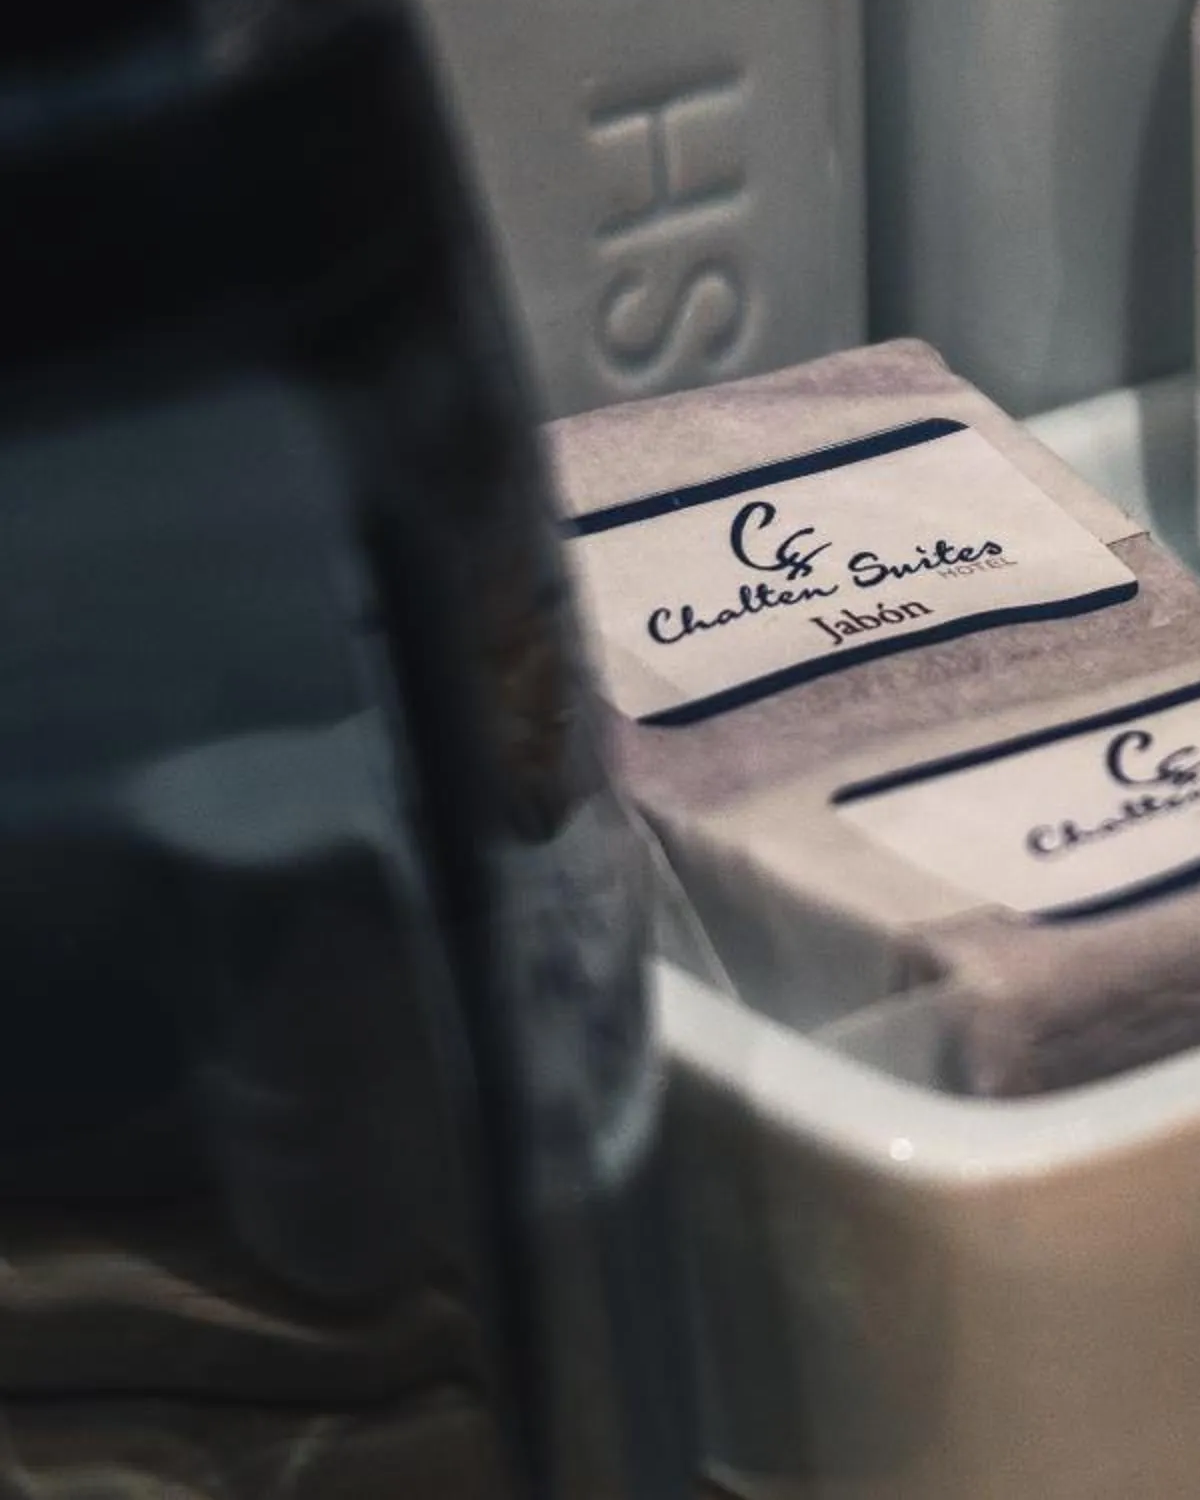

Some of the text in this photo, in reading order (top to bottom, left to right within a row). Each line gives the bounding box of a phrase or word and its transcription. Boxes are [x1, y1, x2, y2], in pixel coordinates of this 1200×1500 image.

[937, 555, 1020, 581] HOTEL
[648, 582, 840, 645] Chalten
[848, 539, 1003, 588] Suites
[811, 600, 935, 645] Jabón
